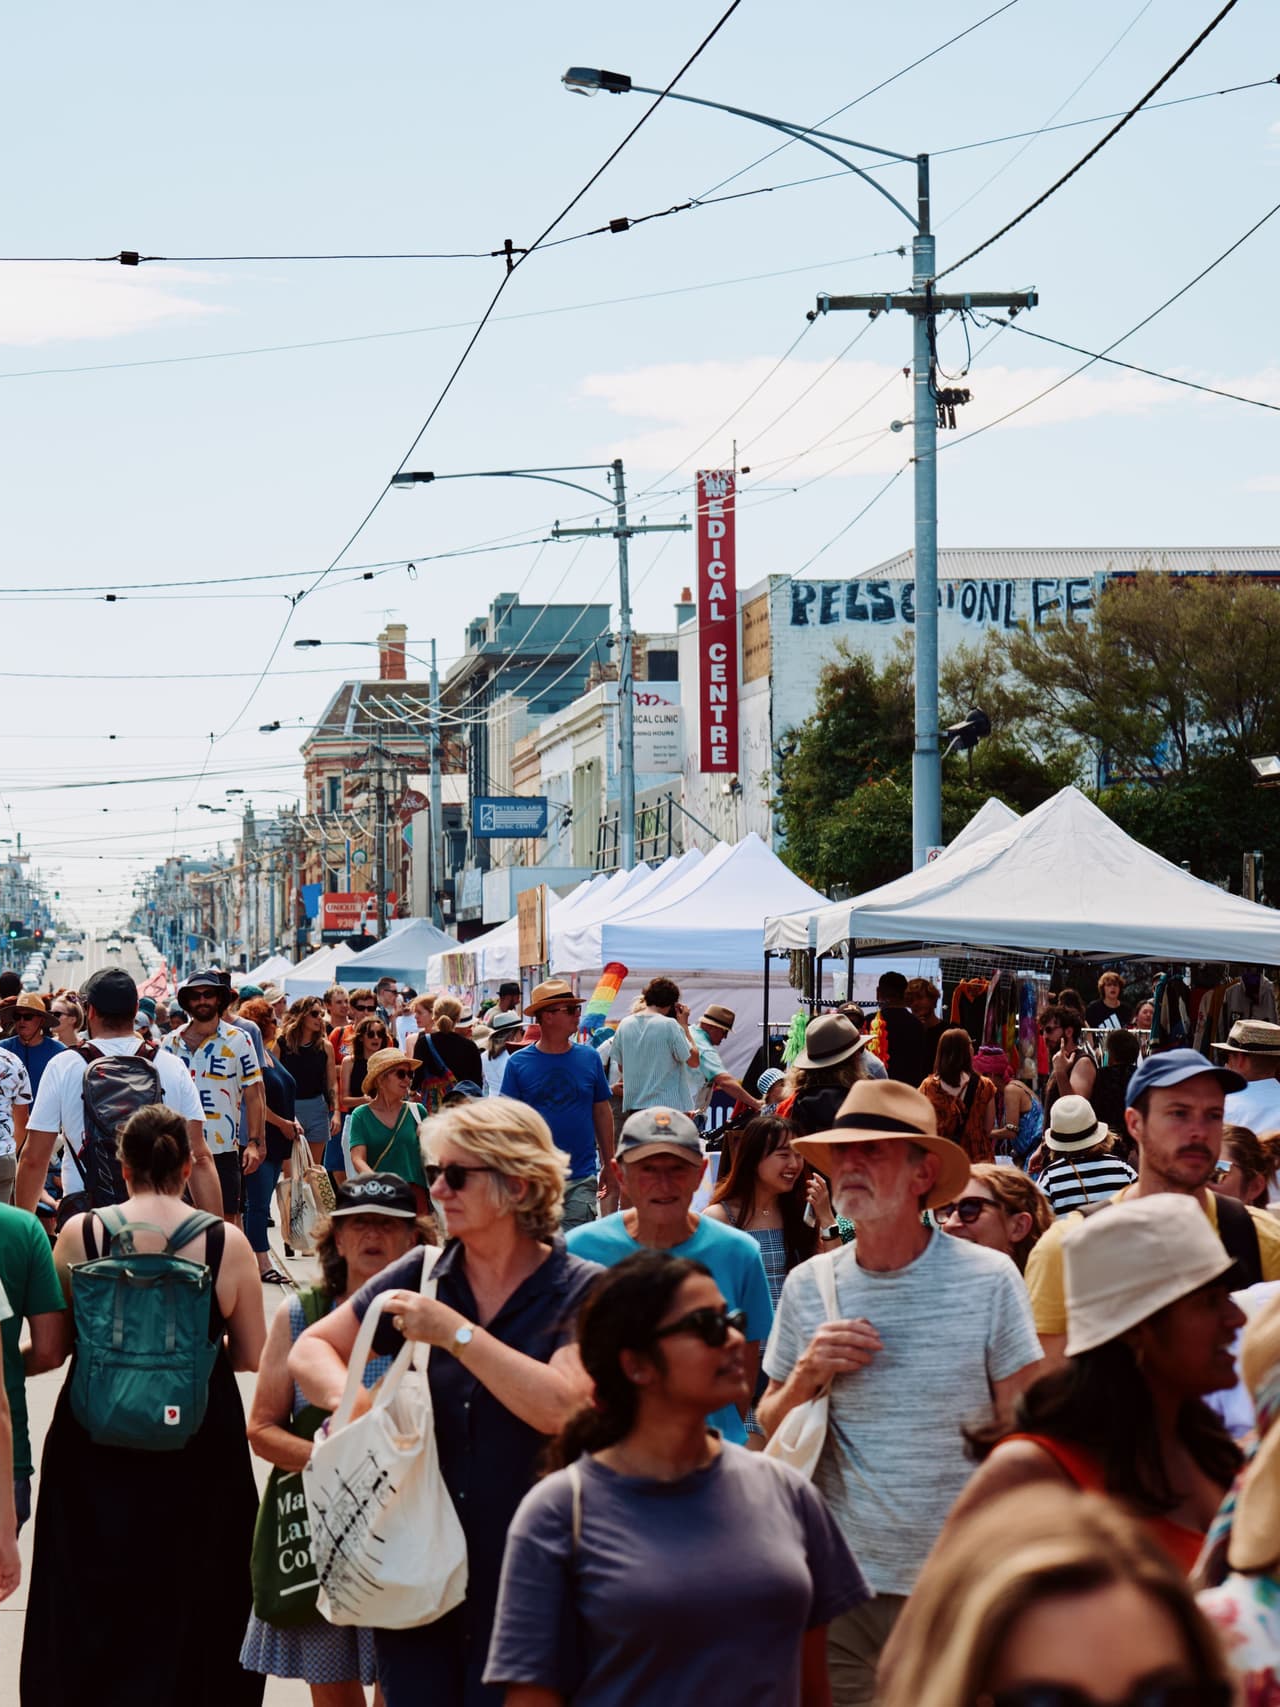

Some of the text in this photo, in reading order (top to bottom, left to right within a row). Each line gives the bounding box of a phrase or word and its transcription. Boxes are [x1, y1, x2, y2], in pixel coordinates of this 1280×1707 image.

[632, 714, 679, 724] DICAL CLINIC
[708, 643, 728, 765] CENTRE
